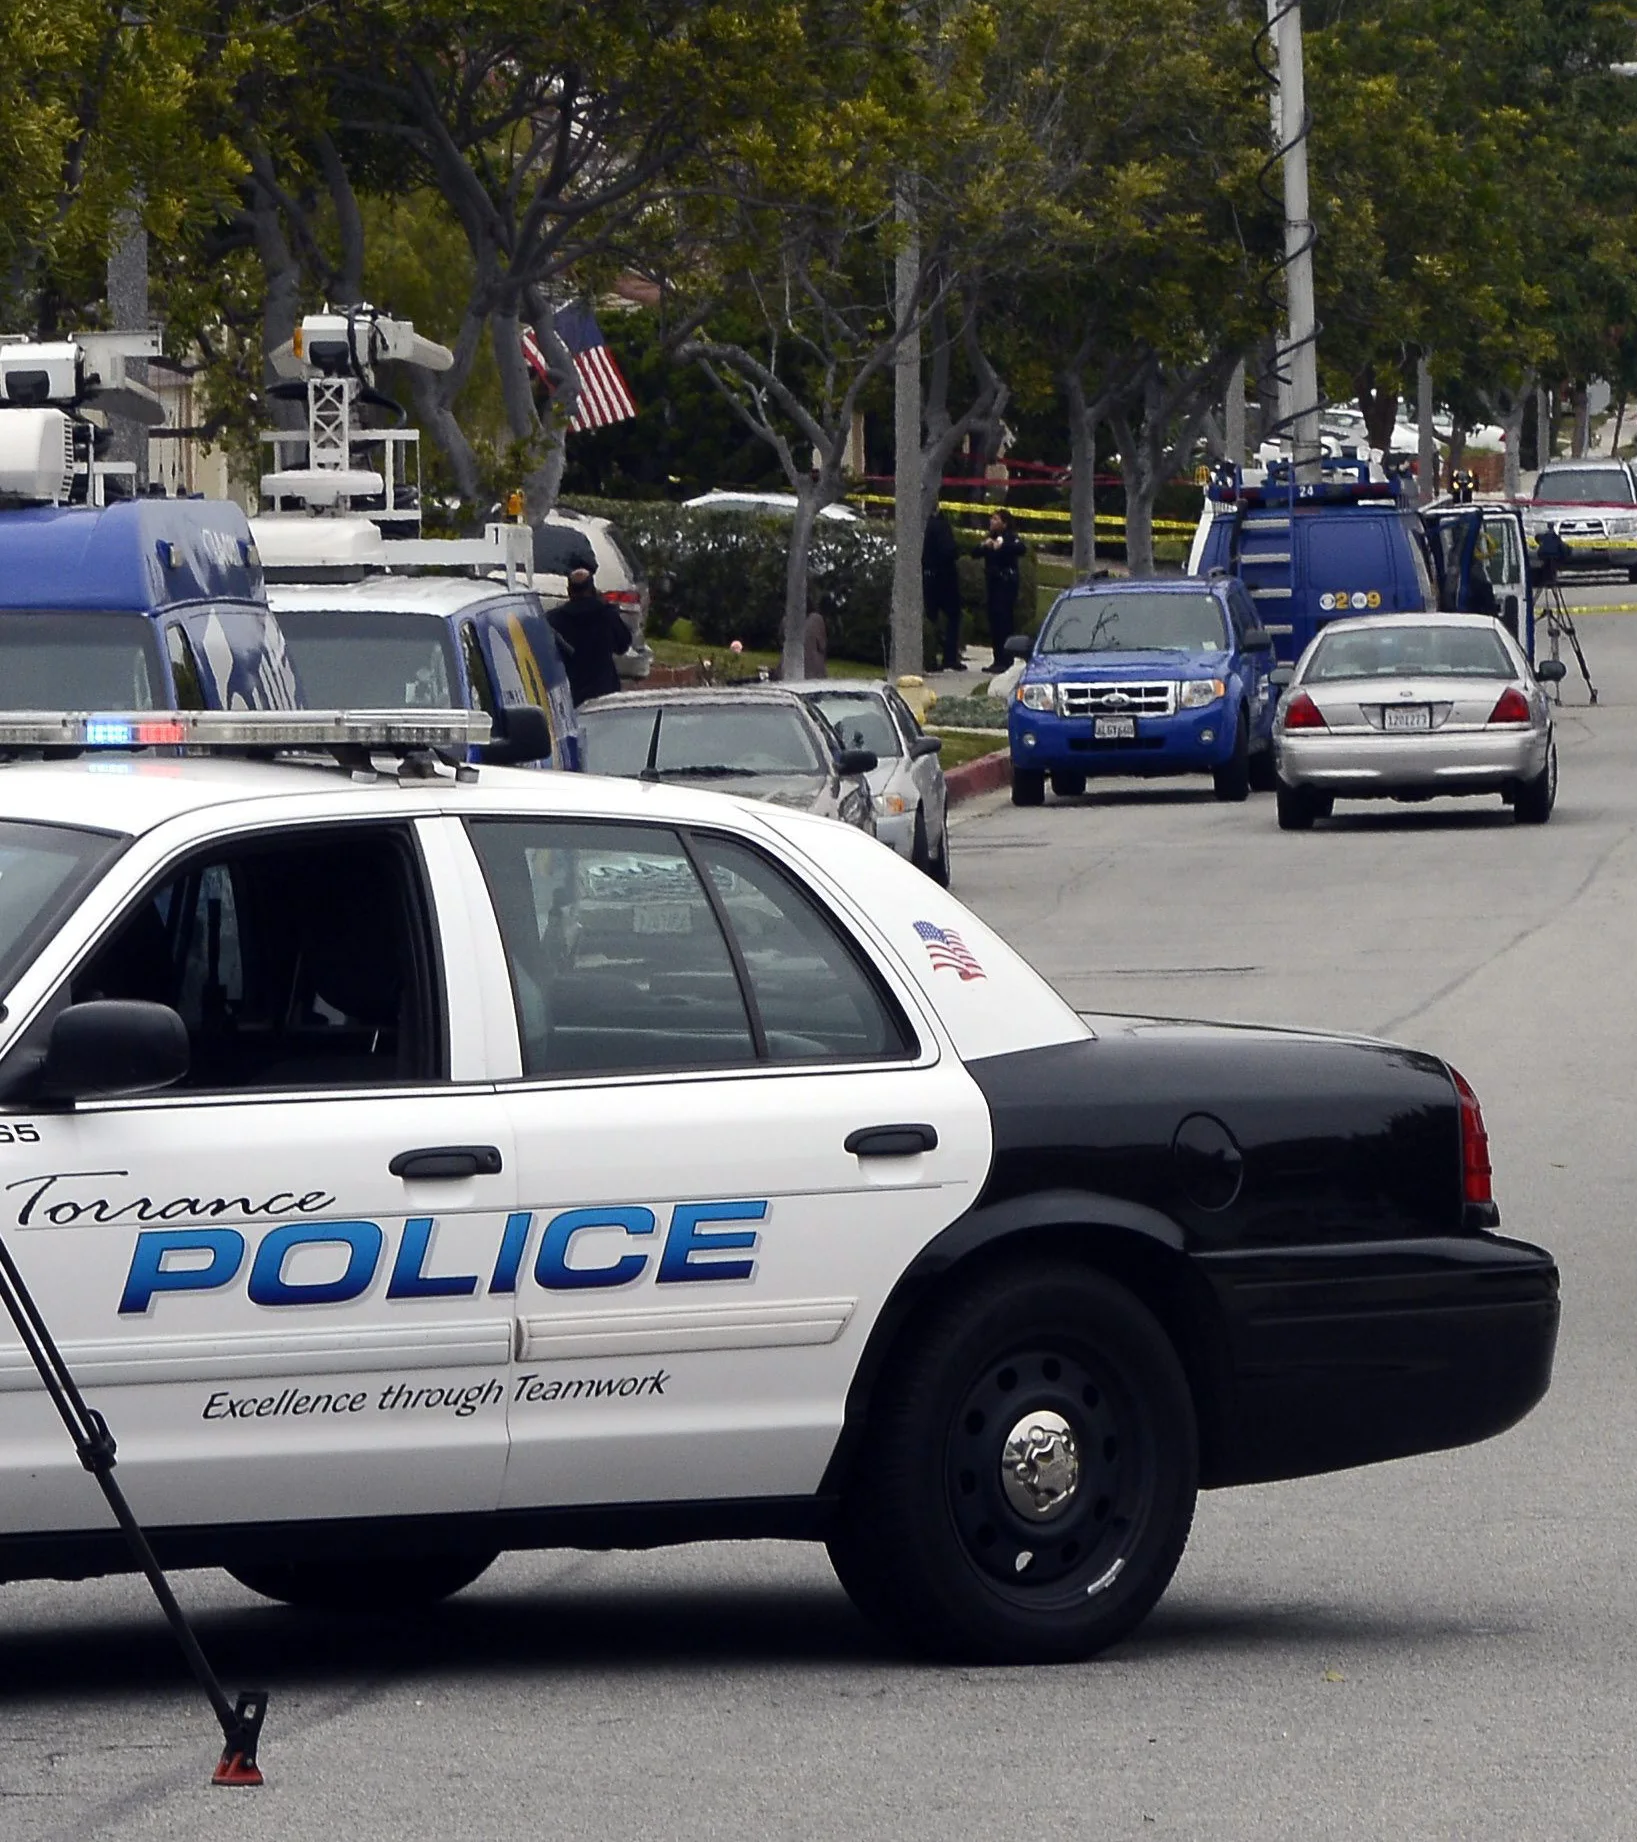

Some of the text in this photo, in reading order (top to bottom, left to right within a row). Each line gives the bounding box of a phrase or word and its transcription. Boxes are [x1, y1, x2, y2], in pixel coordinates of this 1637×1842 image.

[1299, 485, 1315, 498] 24
[6, 1170, 336, 1226] Torrance
[117, 1200, 770, 1315] POLICE
[202, 1369, 672, 1420] Excellence through Teamwork
